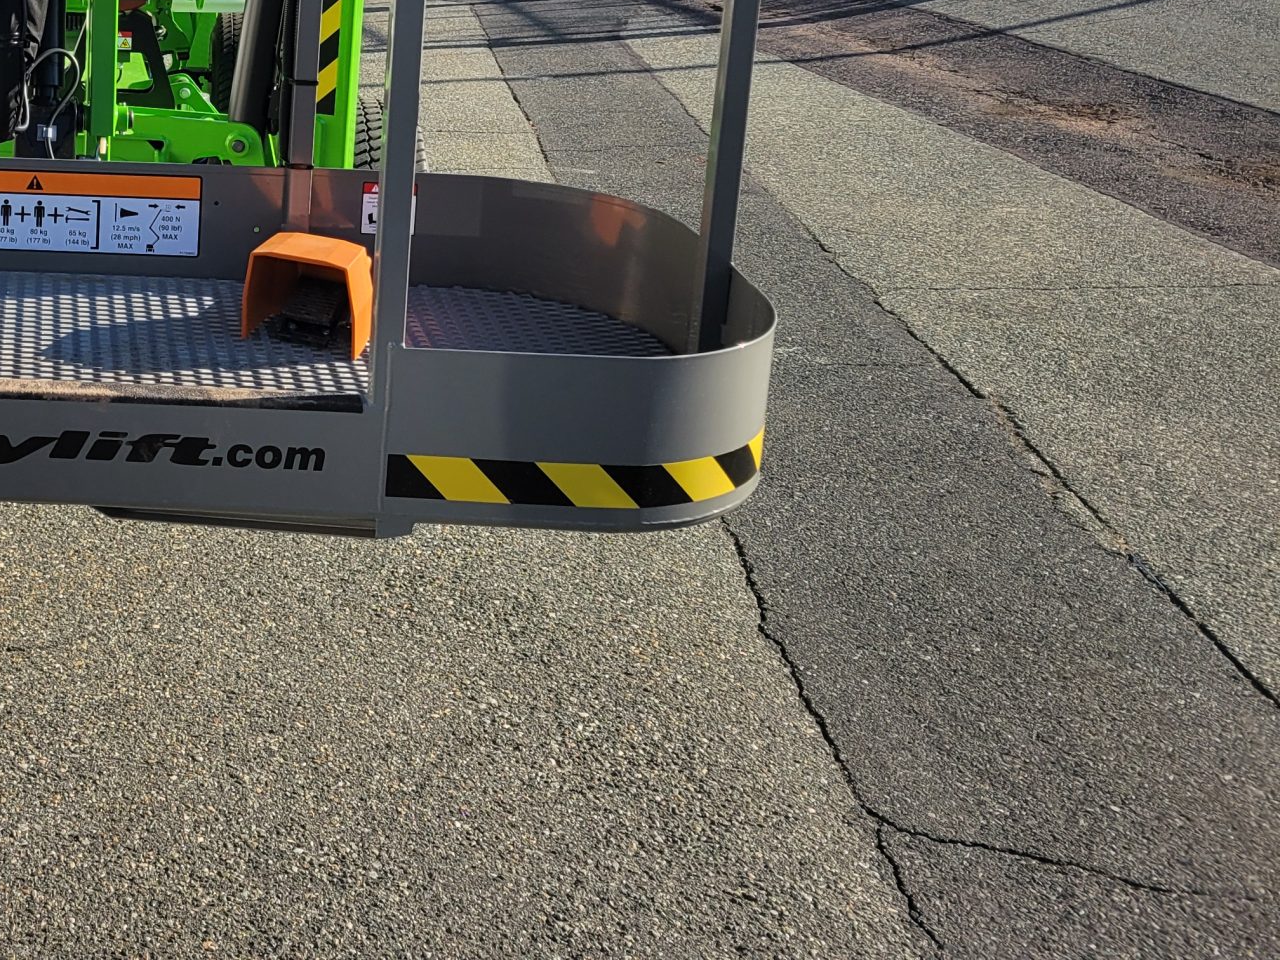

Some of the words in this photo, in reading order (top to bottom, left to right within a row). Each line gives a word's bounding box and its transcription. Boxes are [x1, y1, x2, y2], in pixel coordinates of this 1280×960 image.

[6, 227, 15, 235] kg
[158, 224, 169, 232] (90
[79, 230, 87, 238] kg
[65, 238, 79, 246] (144
[81, 239, 90, 247] lb)
